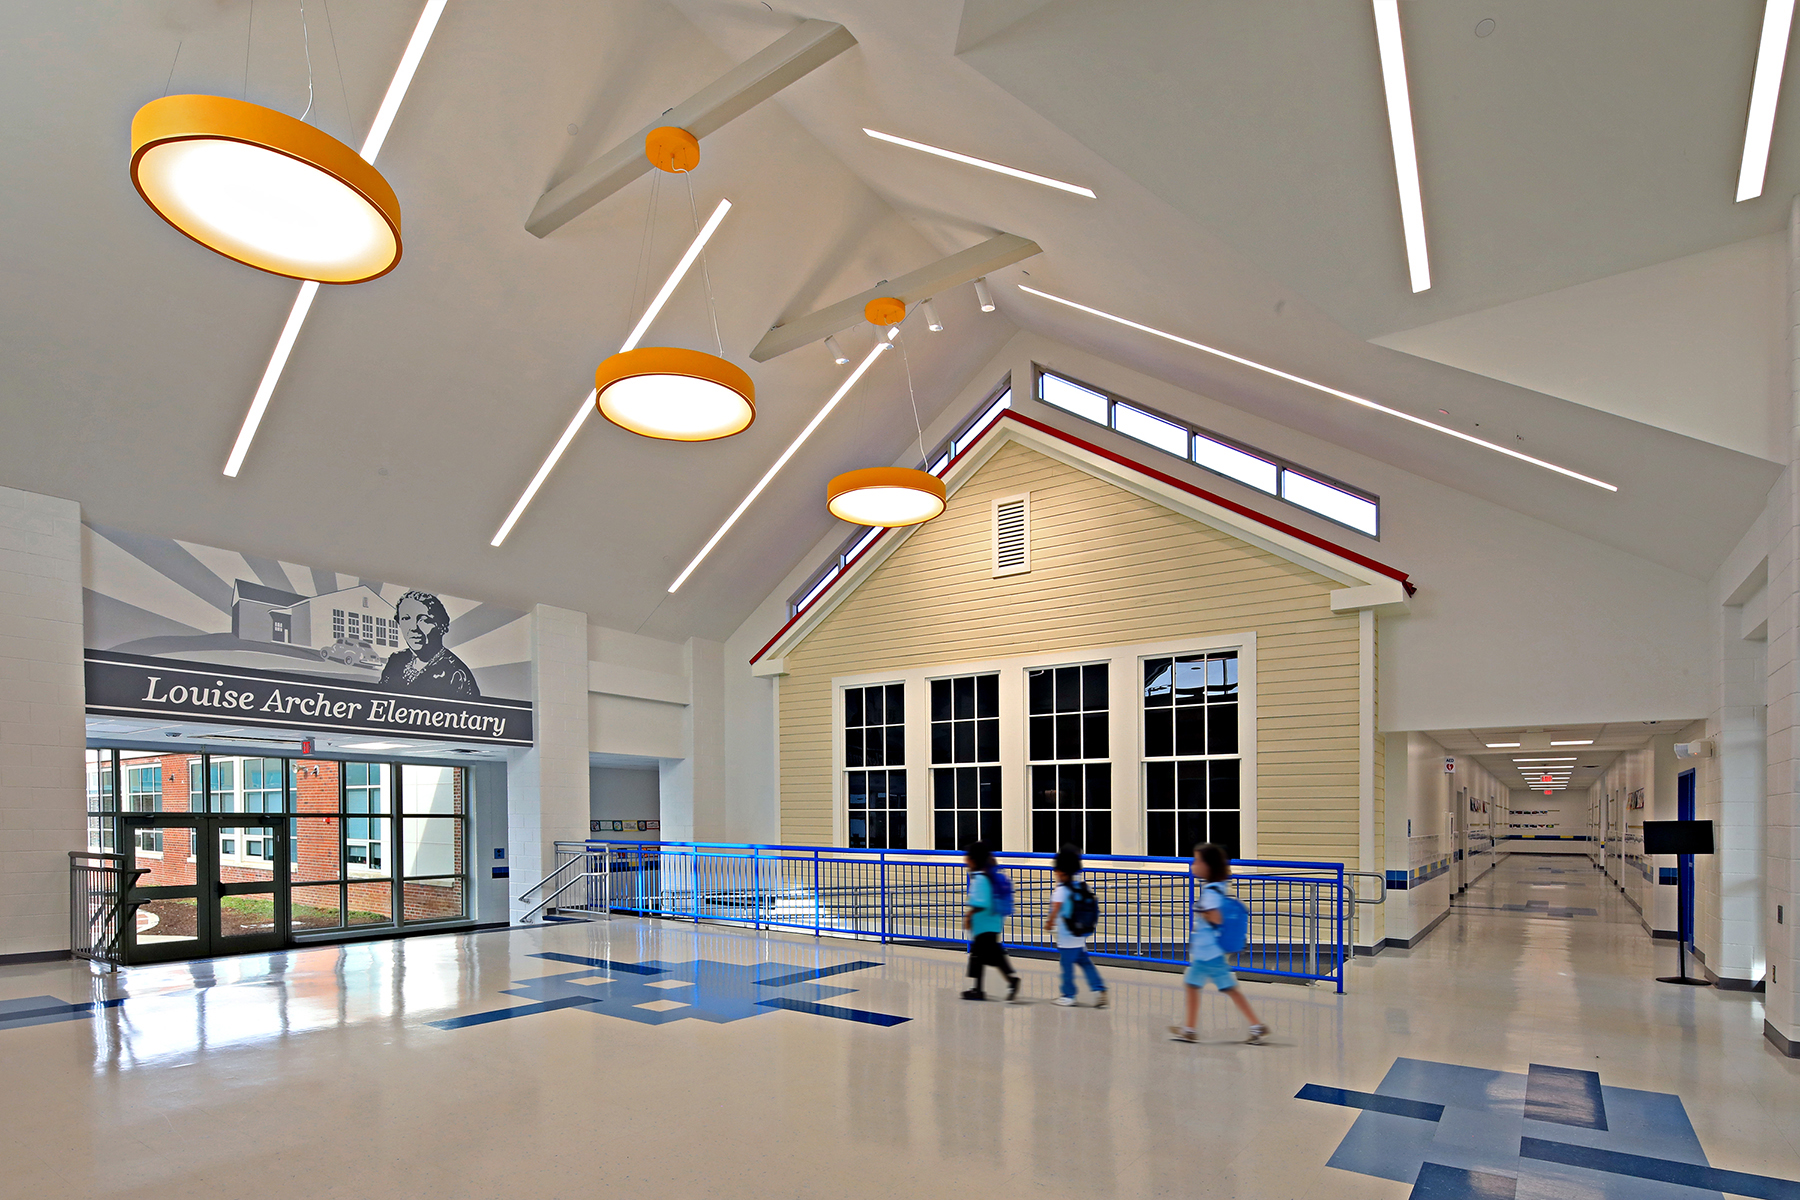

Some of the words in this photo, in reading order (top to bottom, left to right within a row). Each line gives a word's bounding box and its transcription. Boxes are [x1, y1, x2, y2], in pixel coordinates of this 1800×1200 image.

[141, 676, 255, 710] Louise
[259, 688, 362, 720] Archer
[366, 699, 507, 737] Elementary
